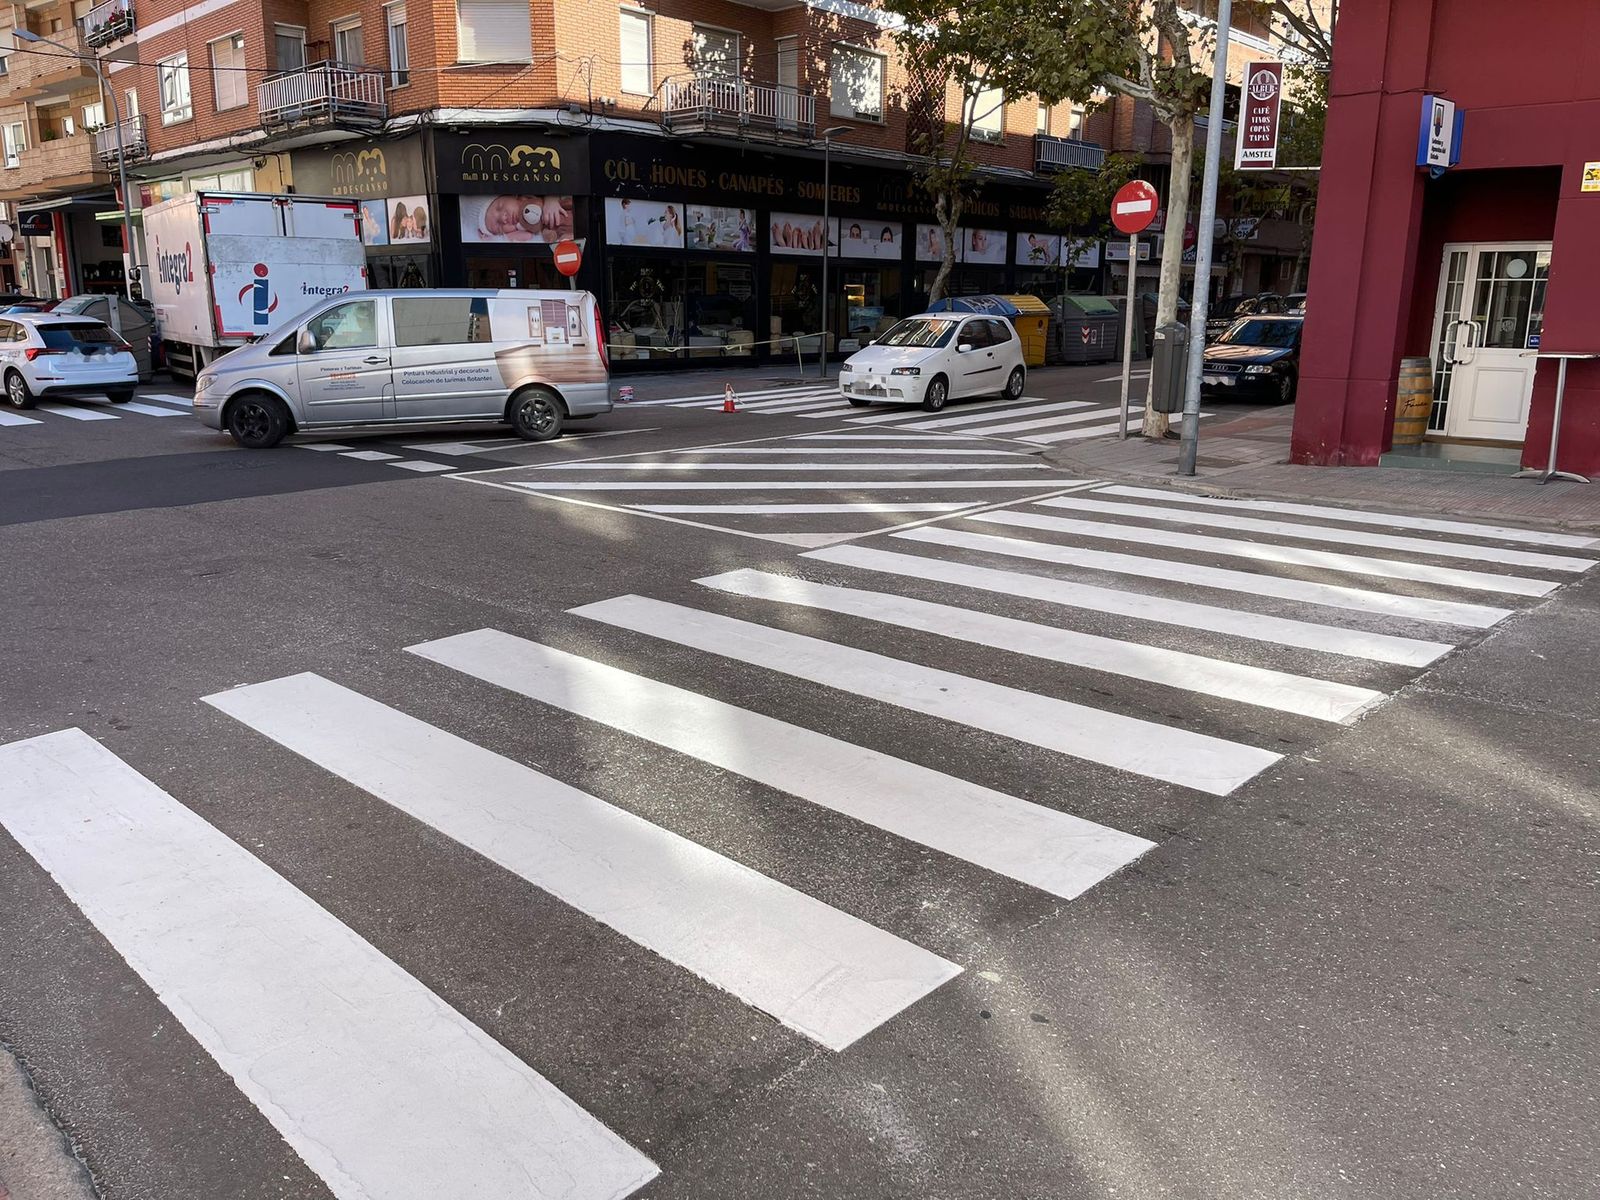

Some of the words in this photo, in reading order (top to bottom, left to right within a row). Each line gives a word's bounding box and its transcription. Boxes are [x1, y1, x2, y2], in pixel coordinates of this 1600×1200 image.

[1242, 150, 1272, 158] AMSTEL
[482, 173, 561, 182] DESCANSO
[719, 174, 784, 196] CANAPÉS
[798, 181, 861, 204] SOMERES
[156, 234, 194, 296] integra2
